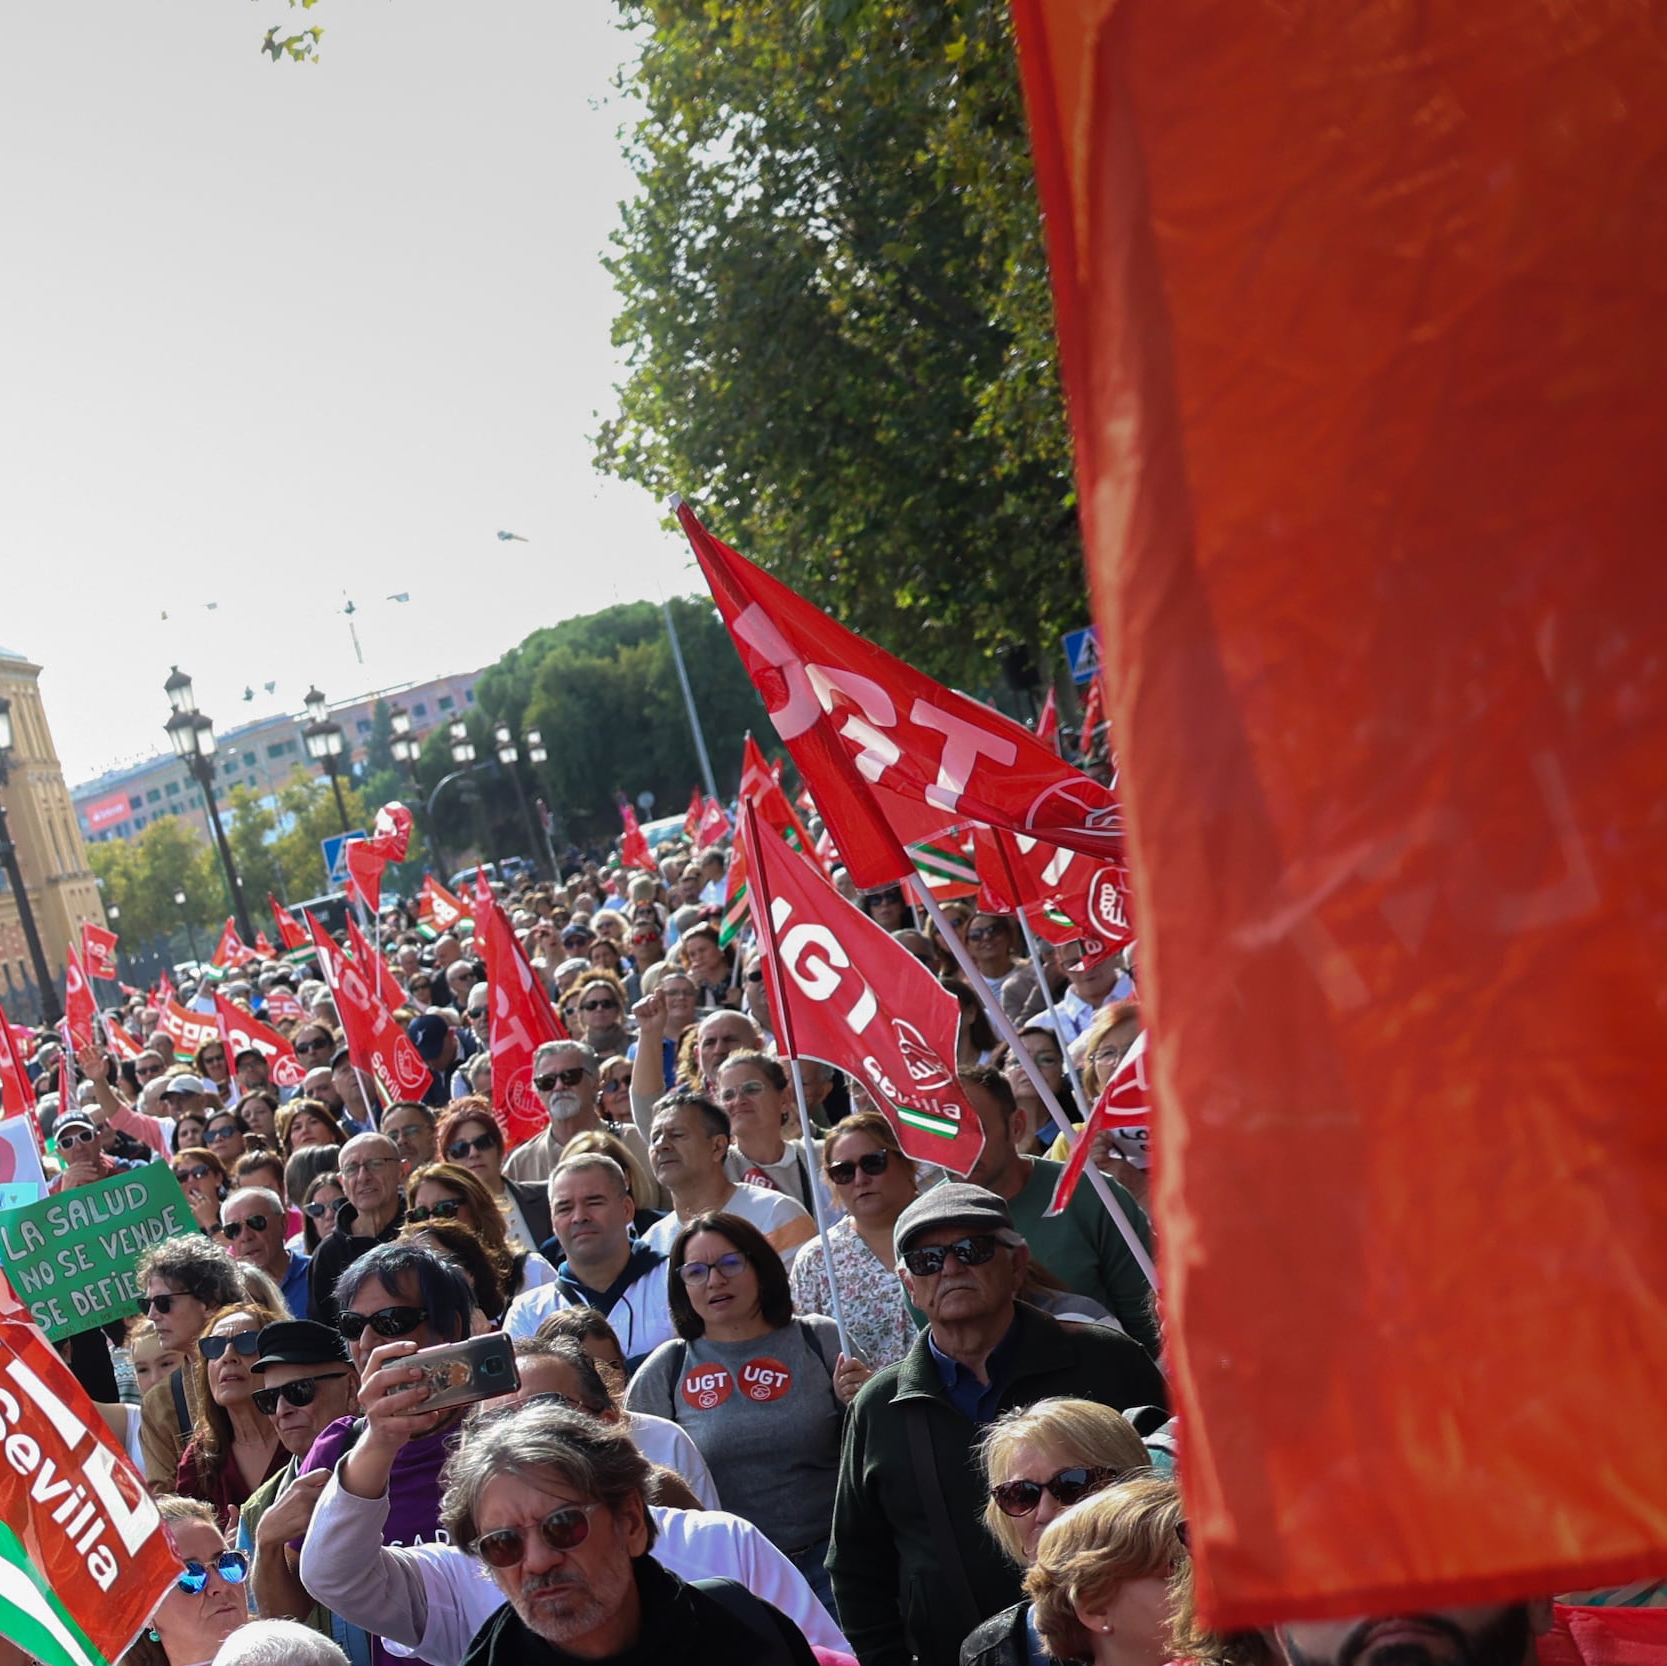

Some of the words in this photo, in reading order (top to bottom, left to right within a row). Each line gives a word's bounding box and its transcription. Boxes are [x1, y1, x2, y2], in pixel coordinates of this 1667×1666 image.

[1, 1220, 46, 1262] LA
[46, 1182, 148, 1238] SALUD
[19, 1260, 56, 1294] NO
[56, 1244, 95, 1278] SE
[99, 1205, 185, 1260] VENDE
[28, 1297, 69, 1333] SE
[70, 1270, 145, 1317] DEFIE
[686, 1372, 728, 1394] UGT
[743, 1365, 789, 1388] UGT
